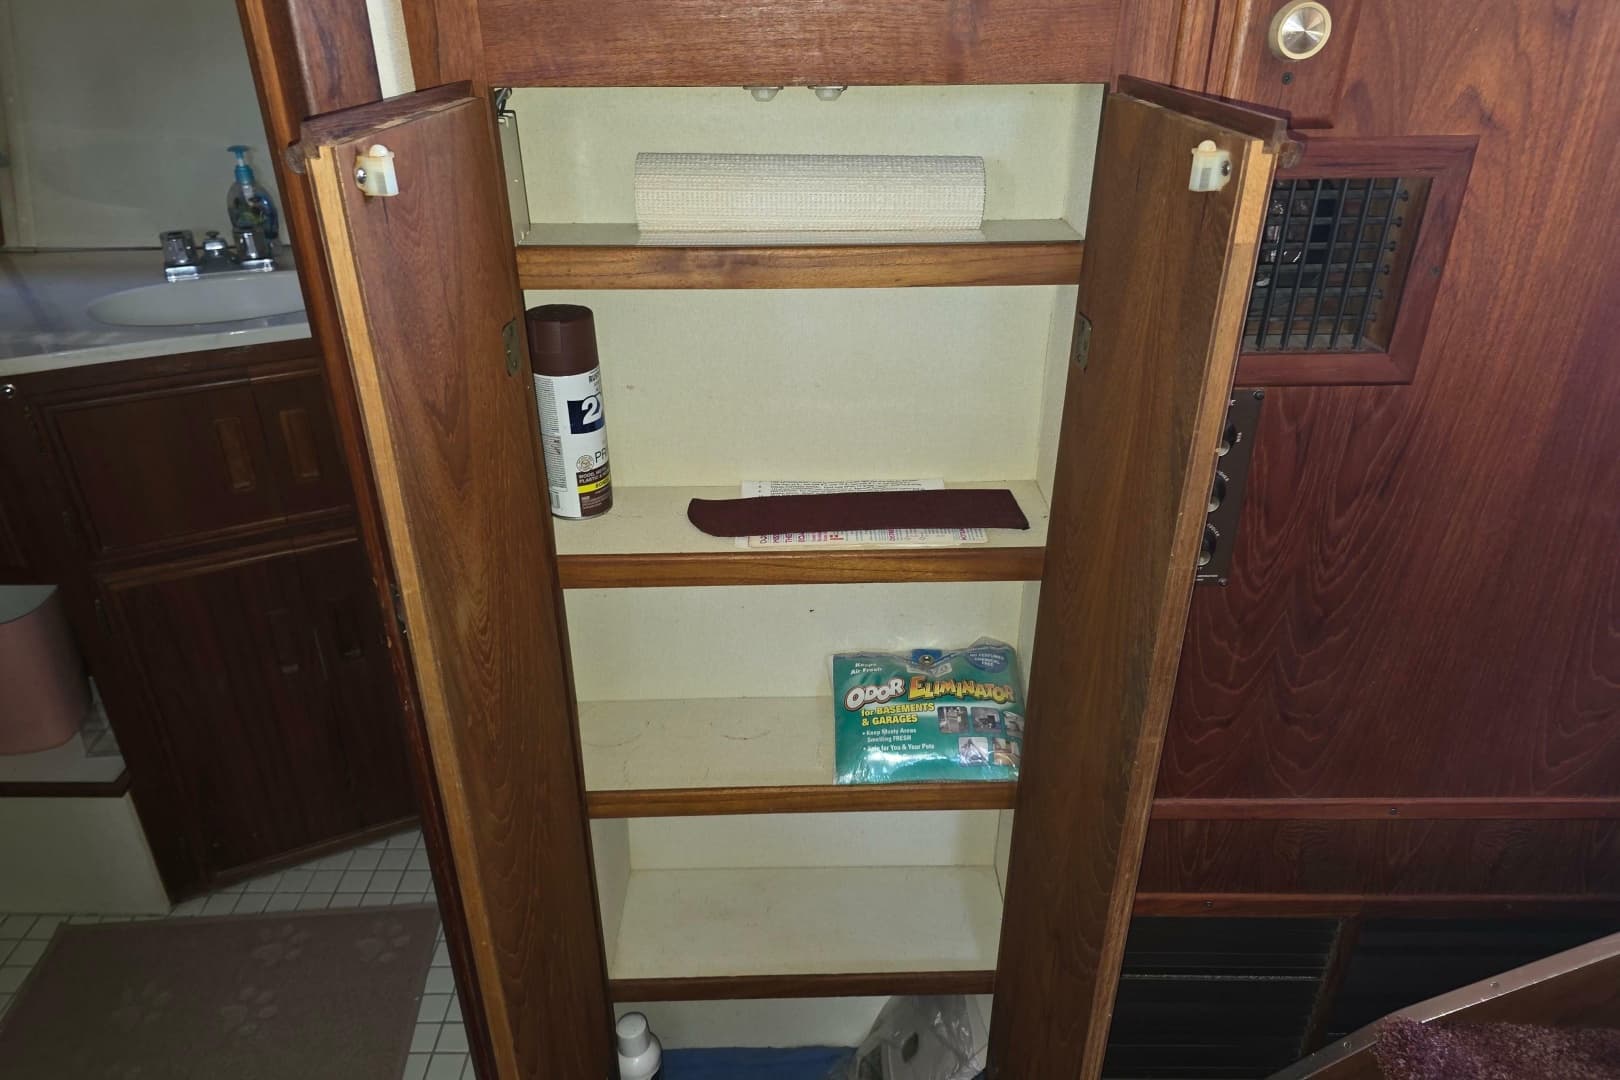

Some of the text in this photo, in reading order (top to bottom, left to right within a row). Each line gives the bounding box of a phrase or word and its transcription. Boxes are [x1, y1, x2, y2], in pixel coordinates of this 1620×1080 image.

[845, 675, 1016, 710] ODOR ELIMINATOR
[861, 702, 935, 717] for BASEMENTS
[862, 714, 918, 726] & GARAGES
